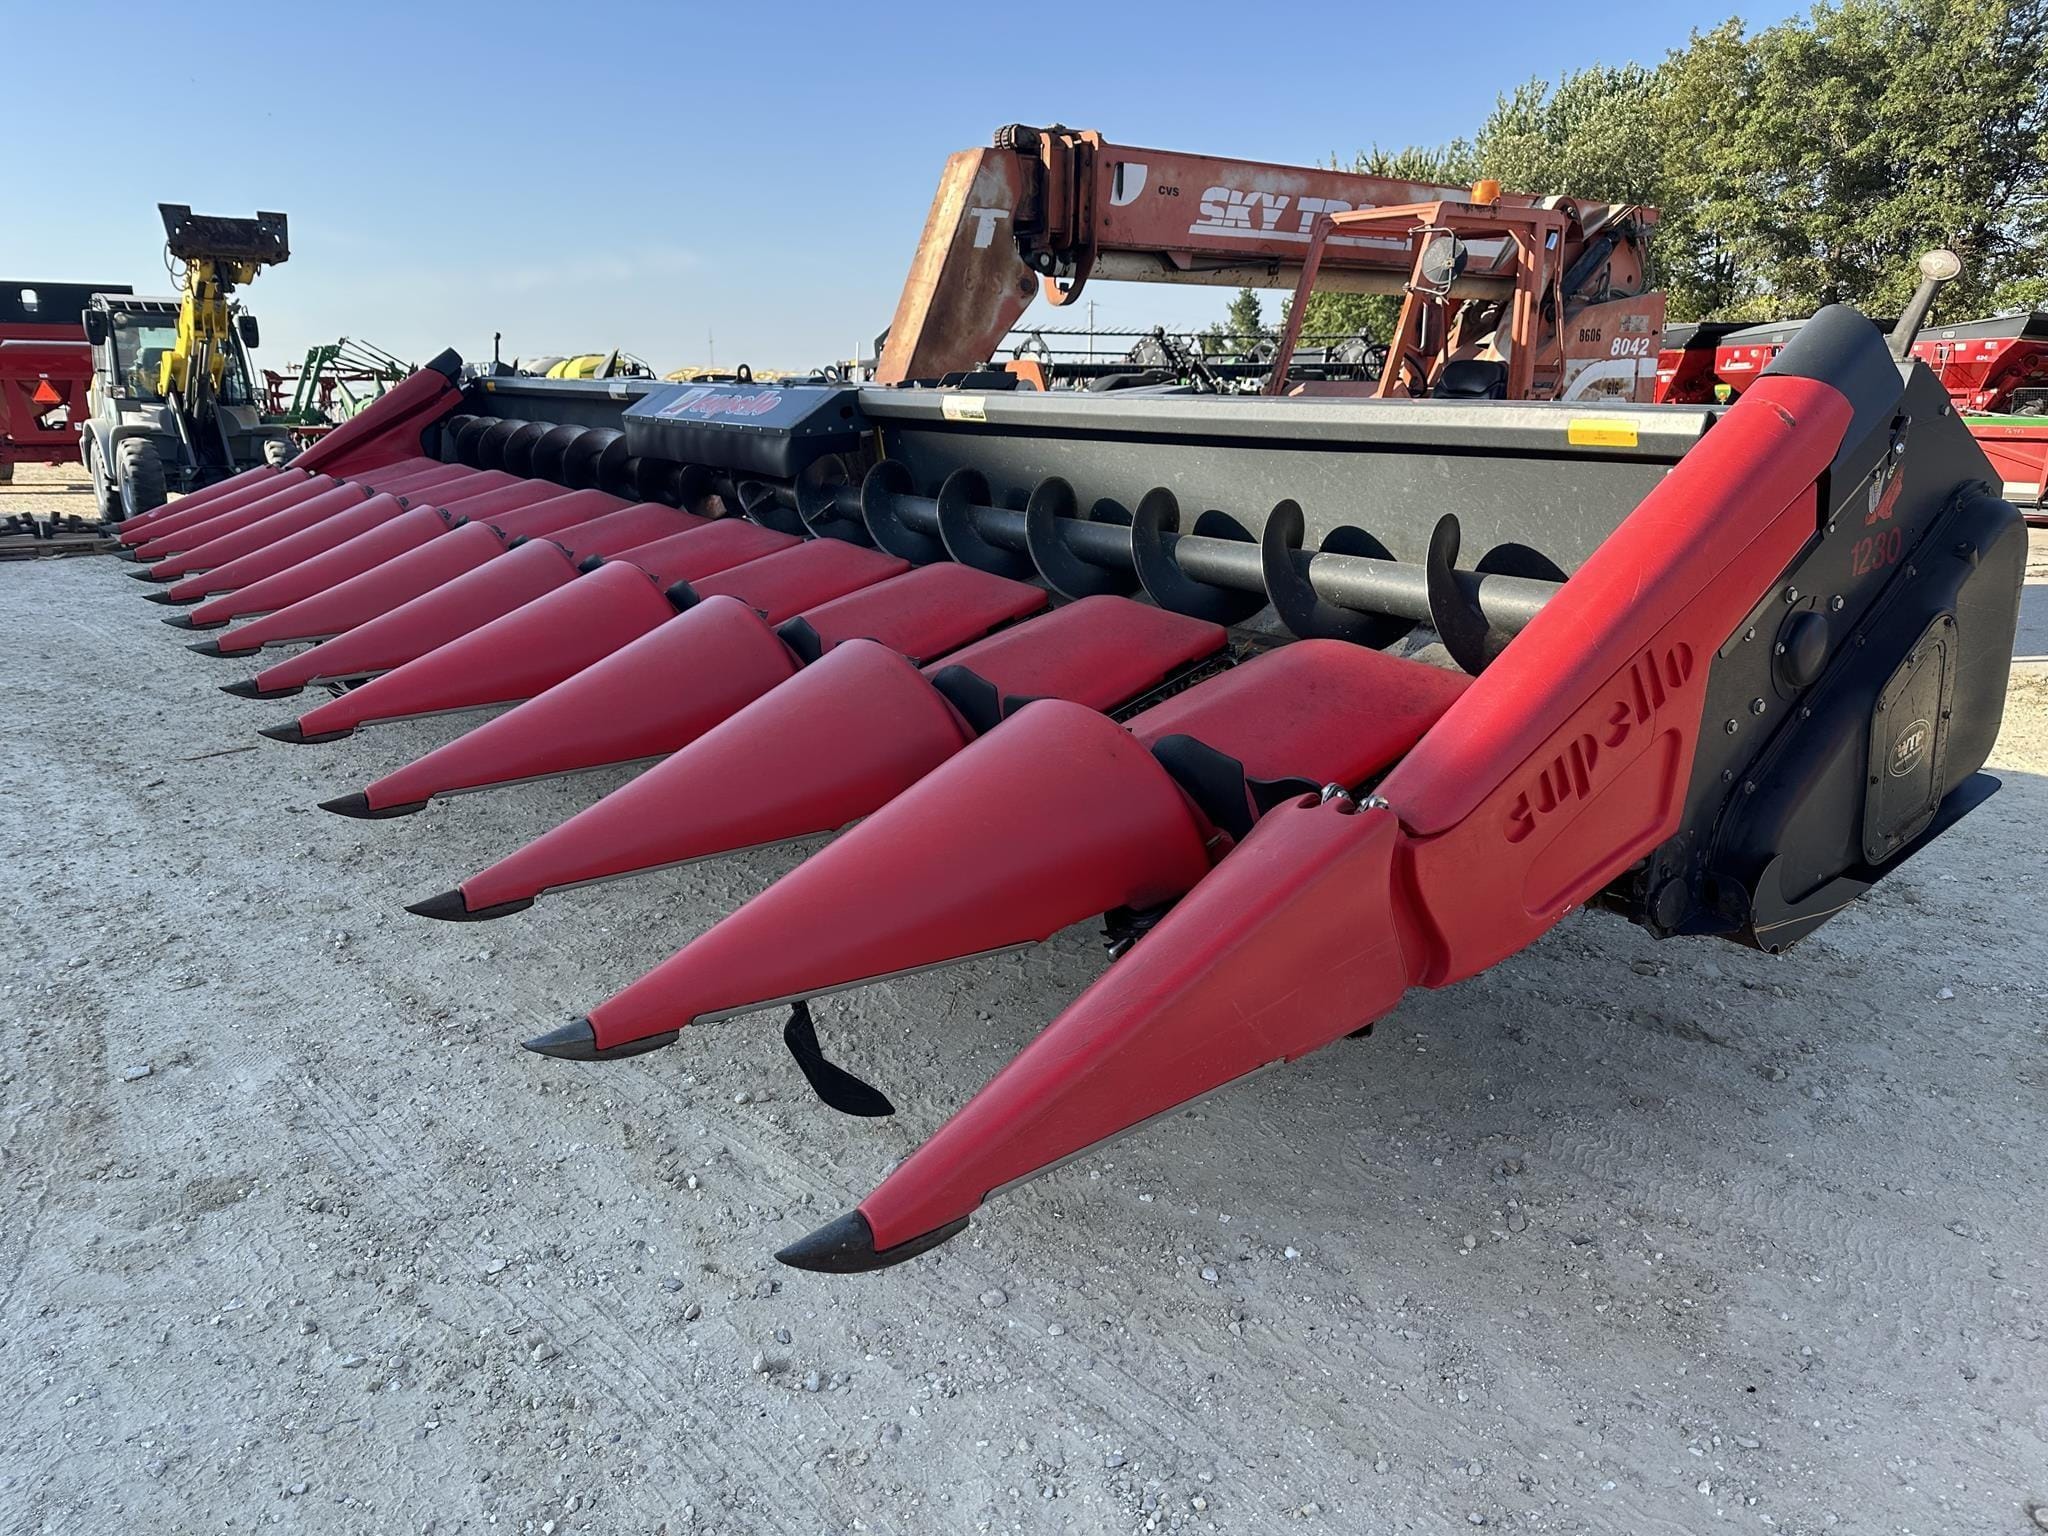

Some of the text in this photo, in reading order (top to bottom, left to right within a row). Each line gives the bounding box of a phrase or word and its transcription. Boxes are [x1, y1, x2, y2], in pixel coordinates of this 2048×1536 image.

[1158, 185, 1180, 198] CVS
[1196, 186, 1290, 230] SKY
[1579, 328, 1602, 343] 8606
[1610, 336, 1650, 356] 8042
[1850, 527, 1903, 577] 1230
